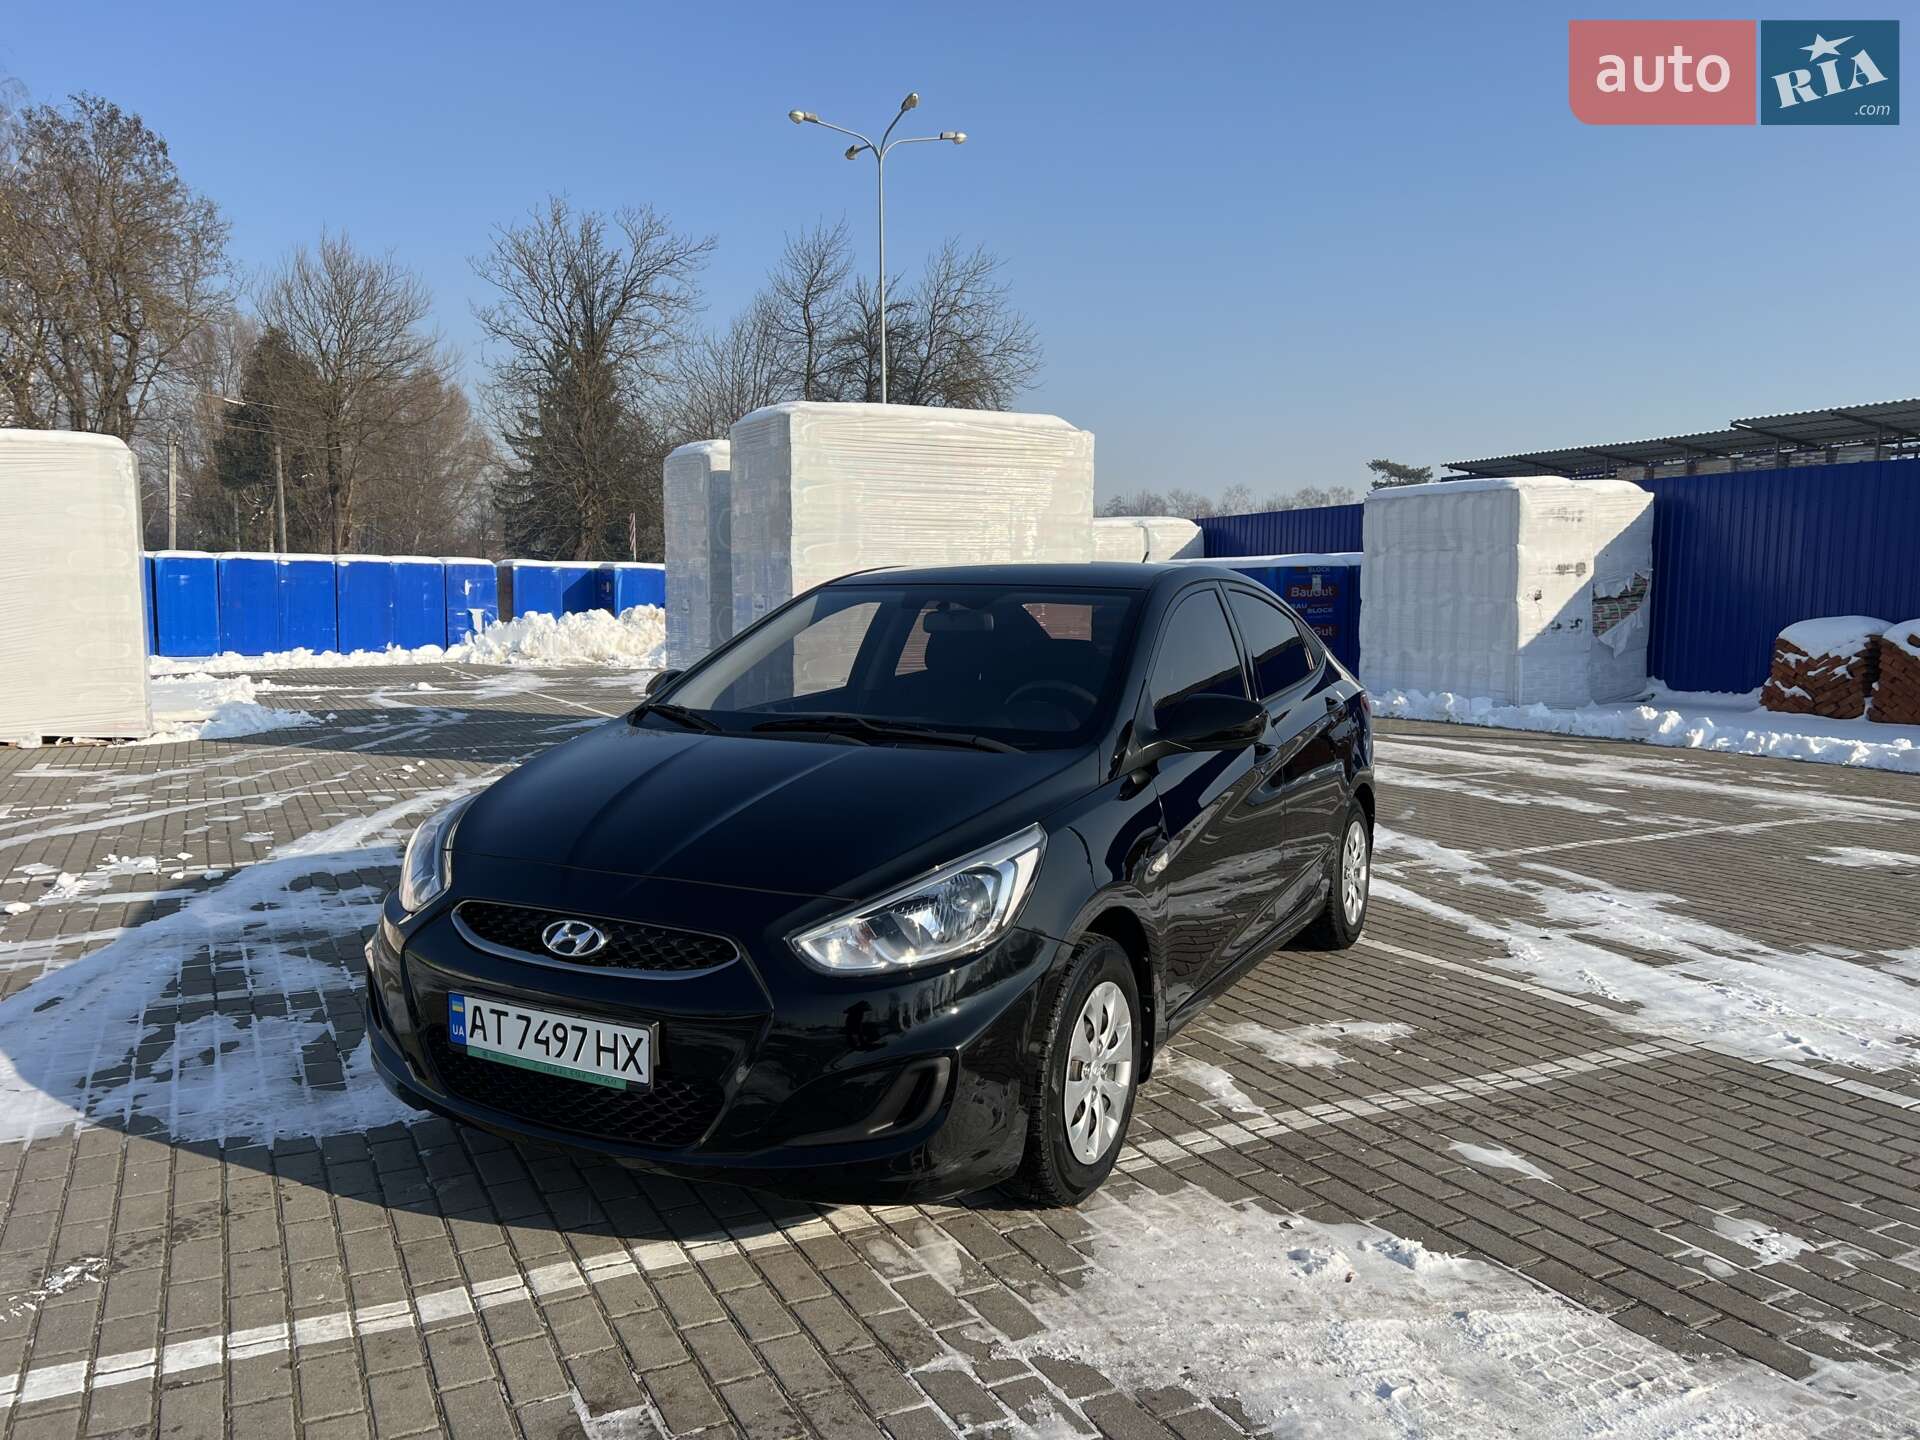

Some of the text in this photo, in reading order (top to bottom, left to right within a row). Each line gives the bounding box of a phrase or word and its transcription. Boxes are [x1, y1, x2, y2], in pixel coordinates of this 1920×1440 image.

[1291, 586, 1334, 597] BauGut
[1313, 625, 1334, 636] Gut
[452, 1024, 464, 1036] UA
[469, 1006, 508, 1045] AT
[516, 1015, 588, 1062] 7497
[596, 1030, 643, 1075] HX
